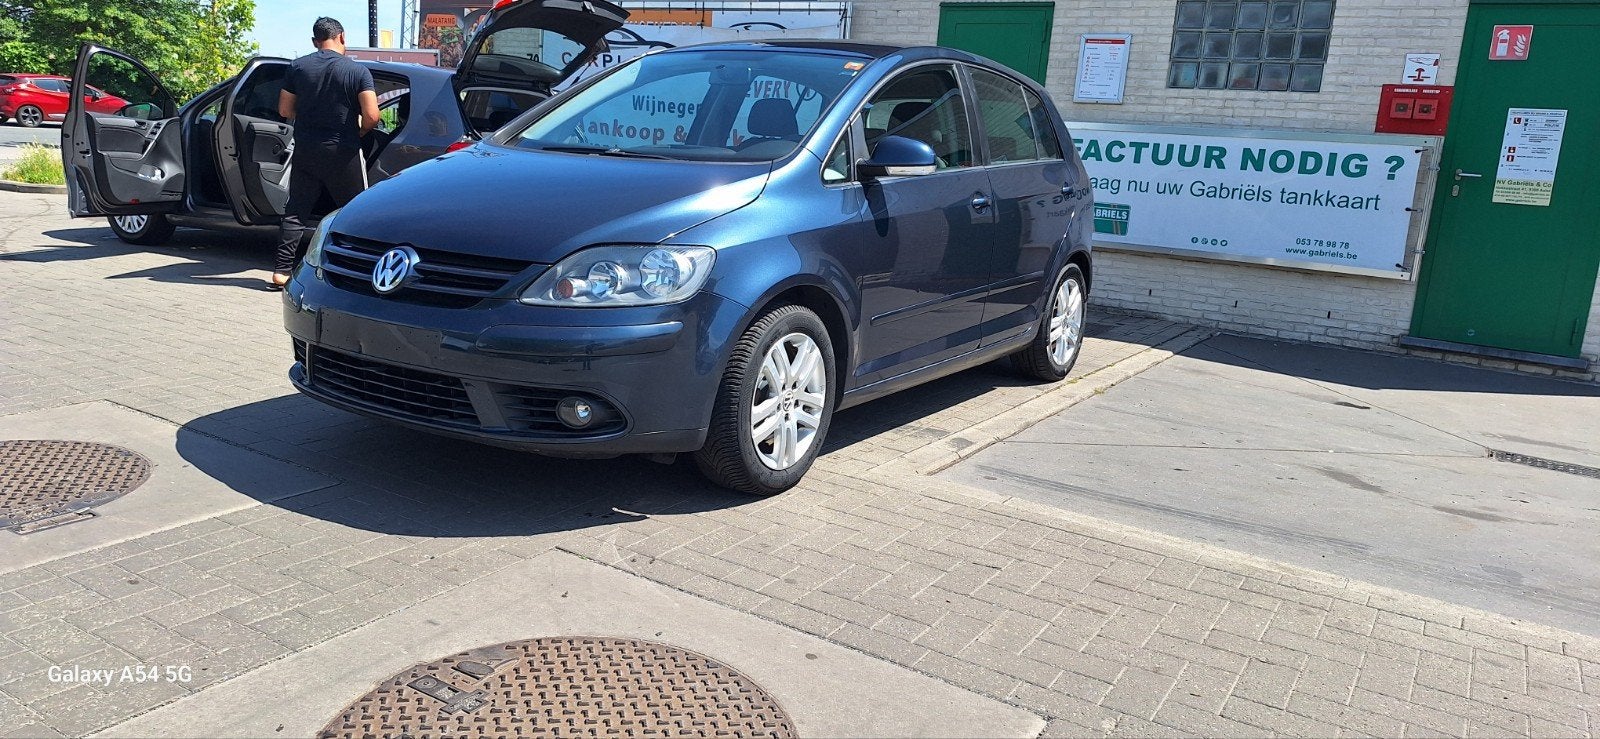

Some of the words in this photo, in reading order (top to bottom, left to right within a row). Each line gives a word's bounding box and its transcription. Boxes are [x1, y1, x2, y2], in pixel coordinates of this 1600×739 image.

[746, 80, 791, 98] VERY
[580, 119, 665, 145] ankoop
[1240, 148, 1370, 179] NODIG
[1383, 155, 1405, 181] ?
[1127, 180, 1150, 193] nu
[1156, 184, 1184, 196] uw
[1190, 180, 1272, 203] Gabriëls
[1280, 188, 1381, 211] tankkaart
[1285, 247, 1358, 260] www.gabriels.be
[1295, 237, 1311, 246] 053
[1314, 239, 1324, 247] 78
[1326, 240, 1337, 248] 98
[1339, 241, 1350, 249] 78
